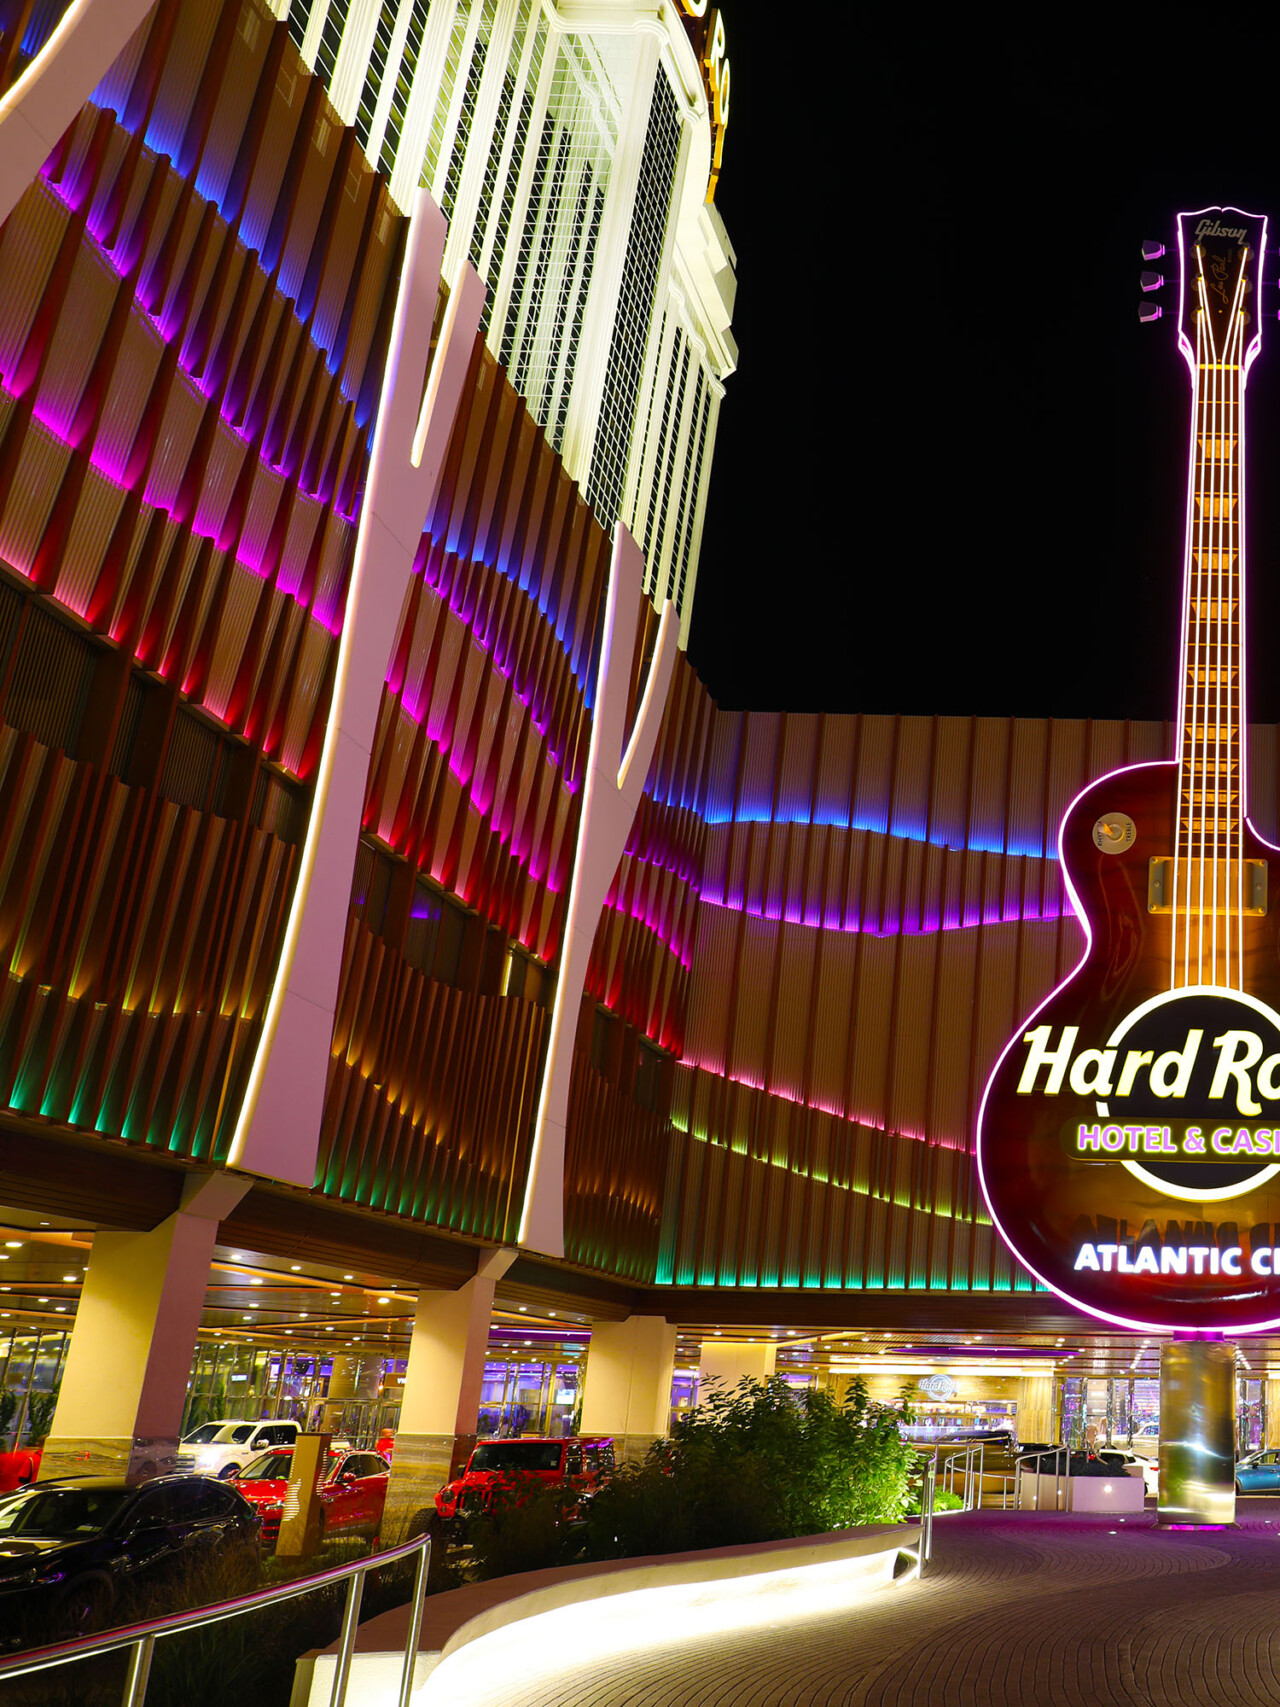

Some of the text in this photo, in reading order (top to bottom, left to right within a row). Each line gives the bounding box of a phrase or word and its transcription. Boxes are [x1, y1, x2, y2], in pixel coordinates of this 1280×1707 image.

[1195, 218, 1248, 245] Gibson
[1210, 254, 1229, 281] Paul
[1016, 1024, 1204, 1099] Hard
[1077, 1123, 1178, 1153] HOTEL
[1183, 1126, 1207, 1154] &
[1073, 1242, 1243, 1276] ATLANTIC
[919, 1378, 939, 1391] Hard
